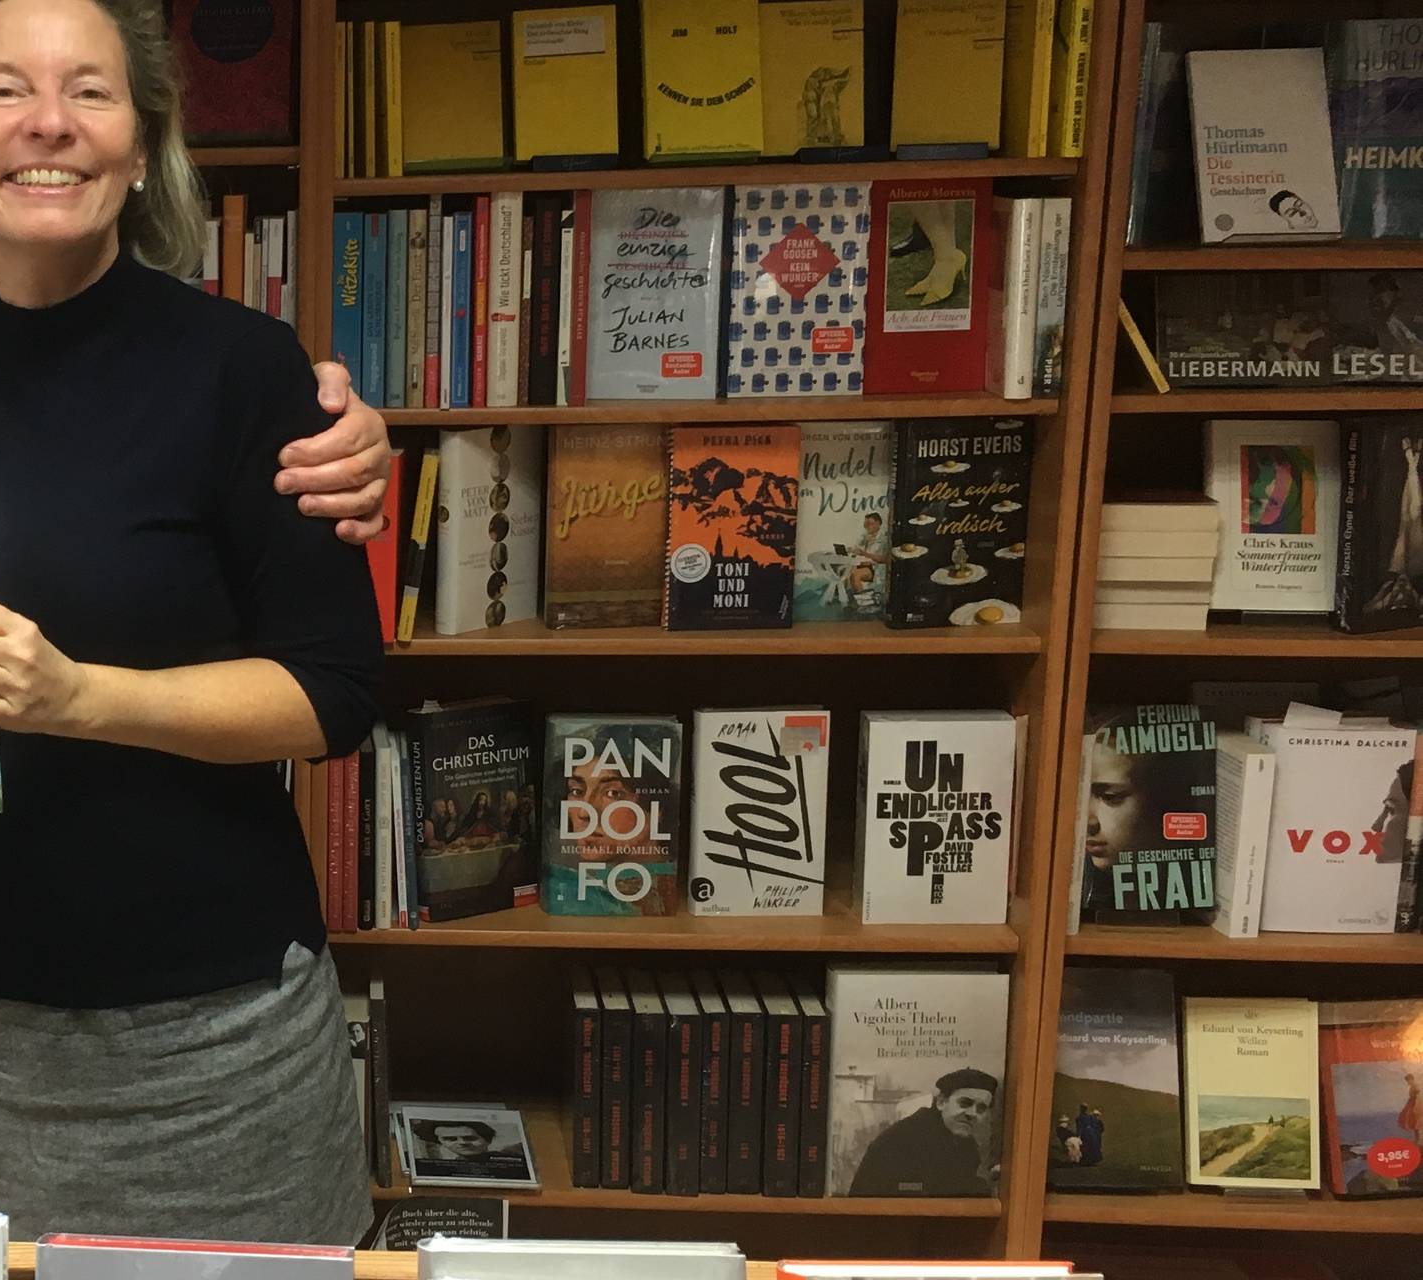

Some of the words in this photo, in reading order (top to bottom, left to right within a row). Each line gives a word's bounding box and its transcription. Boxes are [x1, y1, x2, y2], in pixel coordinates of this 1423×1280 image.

[715, 26, 738, 35] HOLT
[1204, 126, 1265, 139] Thomas
[1205, 141, 1288, 155] Hürlimann
[1207, 157, 1233, 170] Die
[1208, 171, 1286, 185] Tessinerin
[889, 188, 929, 199] Alberto
[636, 207, 680, 229] Die
[499, 205, 512, 266] Deutschland?
[786, 238, 816, 249] FRANK
[783, 249, 818, 260] GOOSEN
[341, 239, 358, 307] Witzekiste
[789, 262, 811, 273] KEIN
[499, 267, 510, 288] tickt
[781, 272, 819, 283] WUNDER
[499, 290, 510, 308] Wie
[604, 306, 684, 333] JULIAN
[610, 333, 690, 353] BARNES
[1168, 361, 1321, 378] LIEBERMANN
[564, 435, 606, 450] HEINZ
[918, 437, 970, 458] HORST
[973, 435, 1023, 455] EVERS
[803, 446, 875, 479] Nudel
[911, 481, 960, 502] Alles
[936, 511, 1007, 536] irdisch
[1243, 537, 1276, 549] Chris
[1279, 538, 1314, 550] Kraus
[1235, 549, 1322, 563] Sommerfrauen
[715, 563, 749, 576] TONI
[1240, 560, 1318, 575] Winterfrauen
[718, 579, 745, 592] UND
[713, 594, 749, 608] MONI
[467, 734, 495, 750] DAS
[1288, 737, 1351, 747] CHRISTINA
[1356, 738, 1409, 749] DALCHER
[432, 746, 529, 772] CHRISTENTUM
[563, 737, 671, 778] PAN
[904, 740, 964, 793] UN
[412, 741, 425, 817] CHRISTENTUM
[703, 717, 825, 894] HOOL
[876, 792, 993, 820] ENDLICHER
[559, 800, 671, 841] DOL
[415, 820, 426, 843] DAS
[560, 844, 613, 855] MICHAEL
[889, 811, 1003, 877] SPASS
[944, 842, 974, 852] DAVID
[1286, 829, 1387, 856] VOX
[925, 852, 973, 865] FOSTER
[1118, 851, 1134, 863] DIE
[1137, 848, 1195, 862] GESCHICHTE
[933, 863, 973, 873] WALLACE
[577, 862, 653, 902] FO
[1112, 861, 1215, 911] FRAU
[763, 885, 810, 898] PHILIPP
[873, 997, 918, 1012] Albert
[853, 1011, 906, 1028] Vigoleis
[908, 1010, 957, 1025] Thelen
[875, 1025, 910, 1037] Meine
[912, 1025, 955, 1037] Heimat
[1202, 1025, 1235, 1035] Eduard
[1237, 1027, 1254, 1035] von
[1256, 1026, 1304, 1039] Keyserling
[895, 1036, 916, 1048] bin
[919, 1036, 938, 1048] ich
[940, 1036, 972, 1048] selbst
[1092, 1035, 1111, 1044] von
[1113, 1033, 1168, 1048] Keyserling
[1238, 1036, 1268, 1047] Wellen
[876, 1046, 910, 1059] Briefe
[1236, 1047, 1270, 1058] Roman
[1376, 1149, 1411, 1163] 3,95€
[402, 1209, 422, 1217] Buch
[425, 1208, 444, 1217] über
